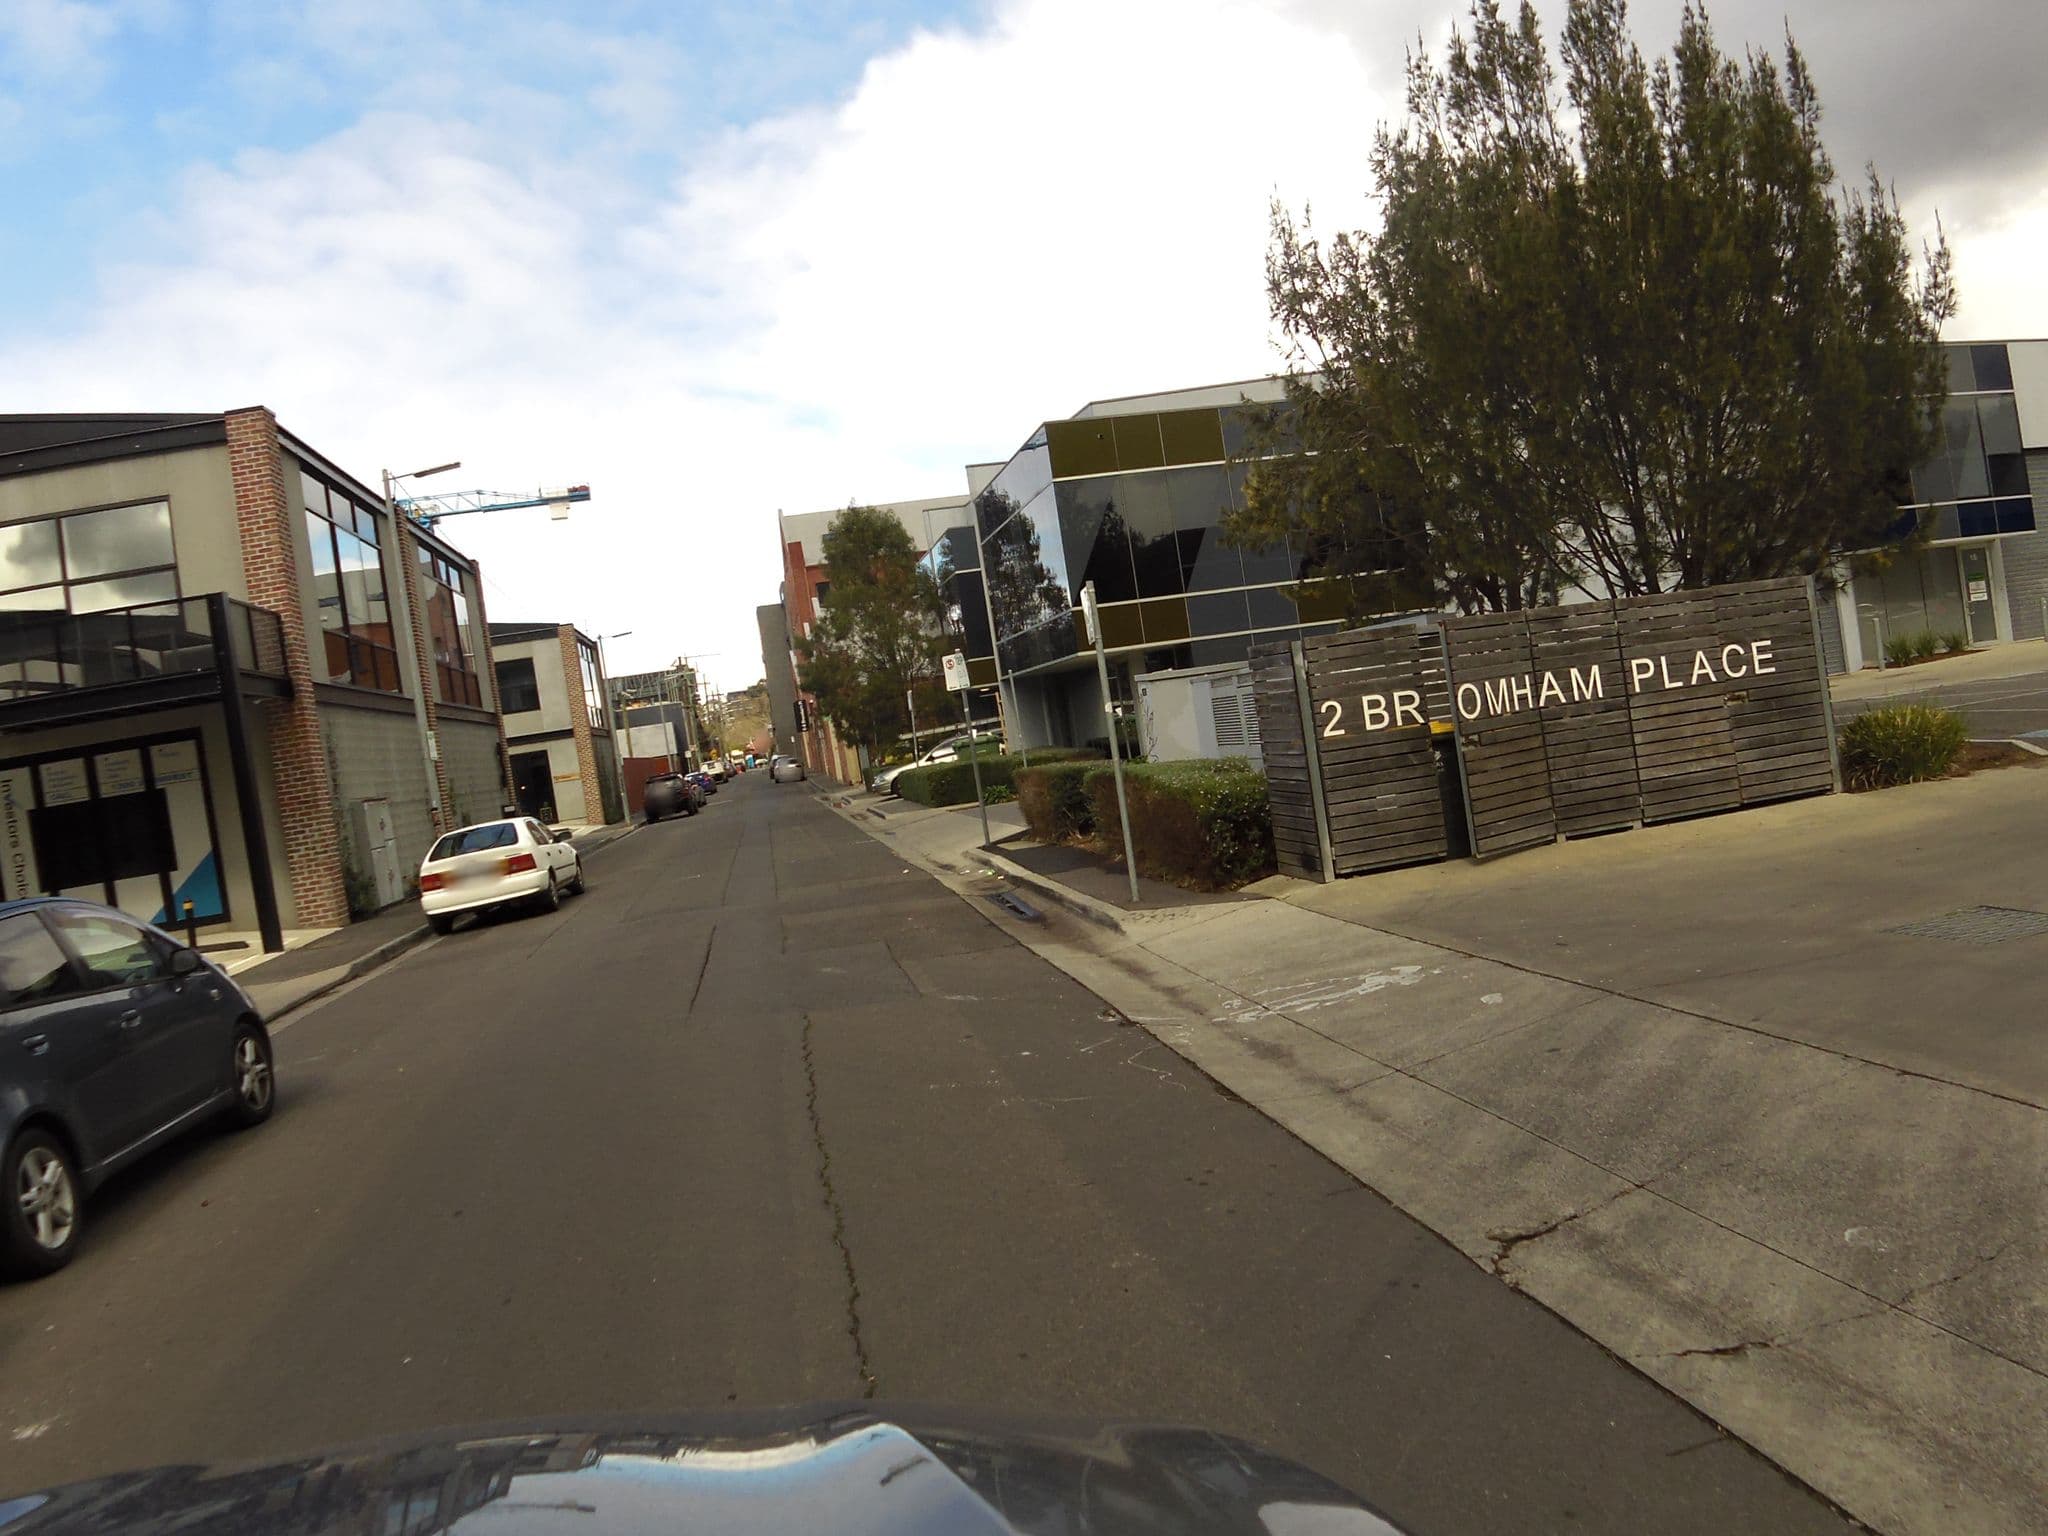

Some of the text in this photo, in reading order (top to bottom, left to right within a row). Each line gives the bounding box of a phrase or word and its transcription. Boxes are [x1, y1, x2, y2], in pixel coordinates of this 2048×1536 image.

[1320, 700, 1345, 738] 2
[1631, 639, 1776, 693] PLACE
[13, 852, 29, 899] Choic
